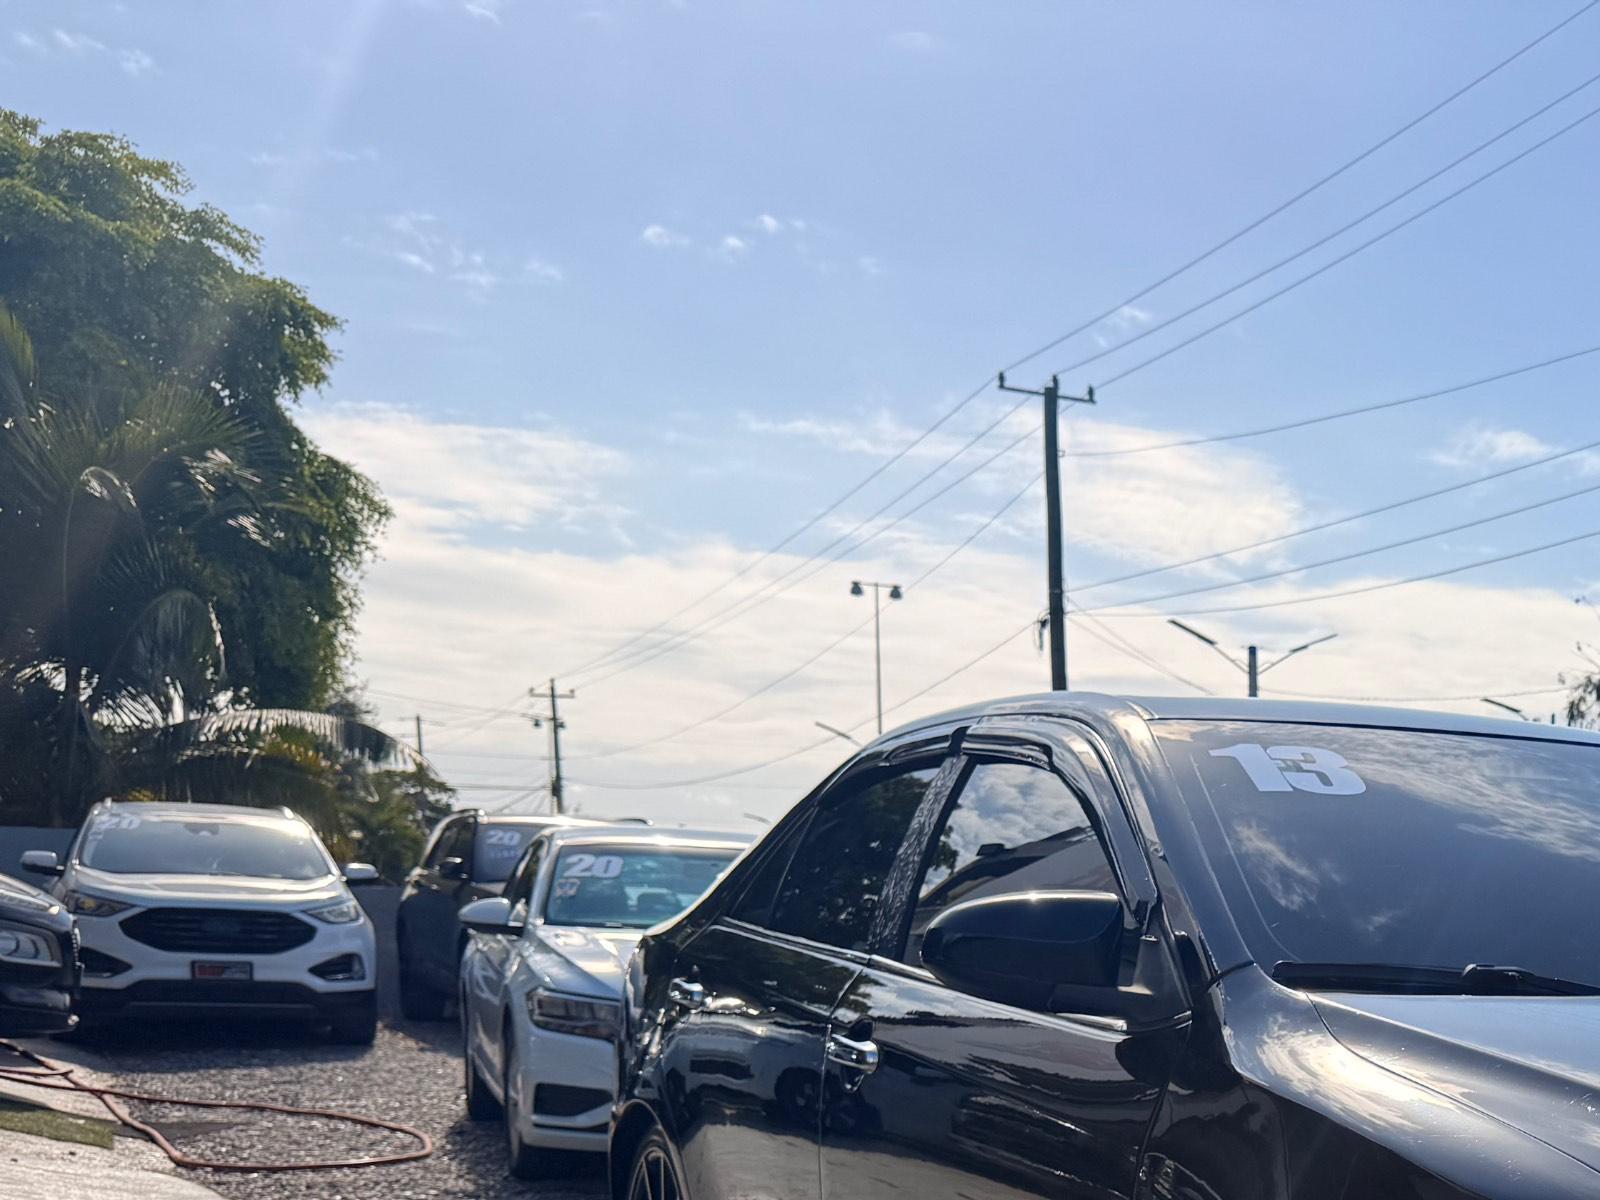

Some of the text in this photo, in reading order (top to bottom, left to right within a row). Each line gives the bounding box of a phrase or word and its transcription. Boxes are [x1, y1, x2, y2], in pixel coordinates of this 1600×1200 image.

[1208, 743, 1367, 796] 13
[485, 829, 522, 846] 20
[563, 853, 625, 879] 20
